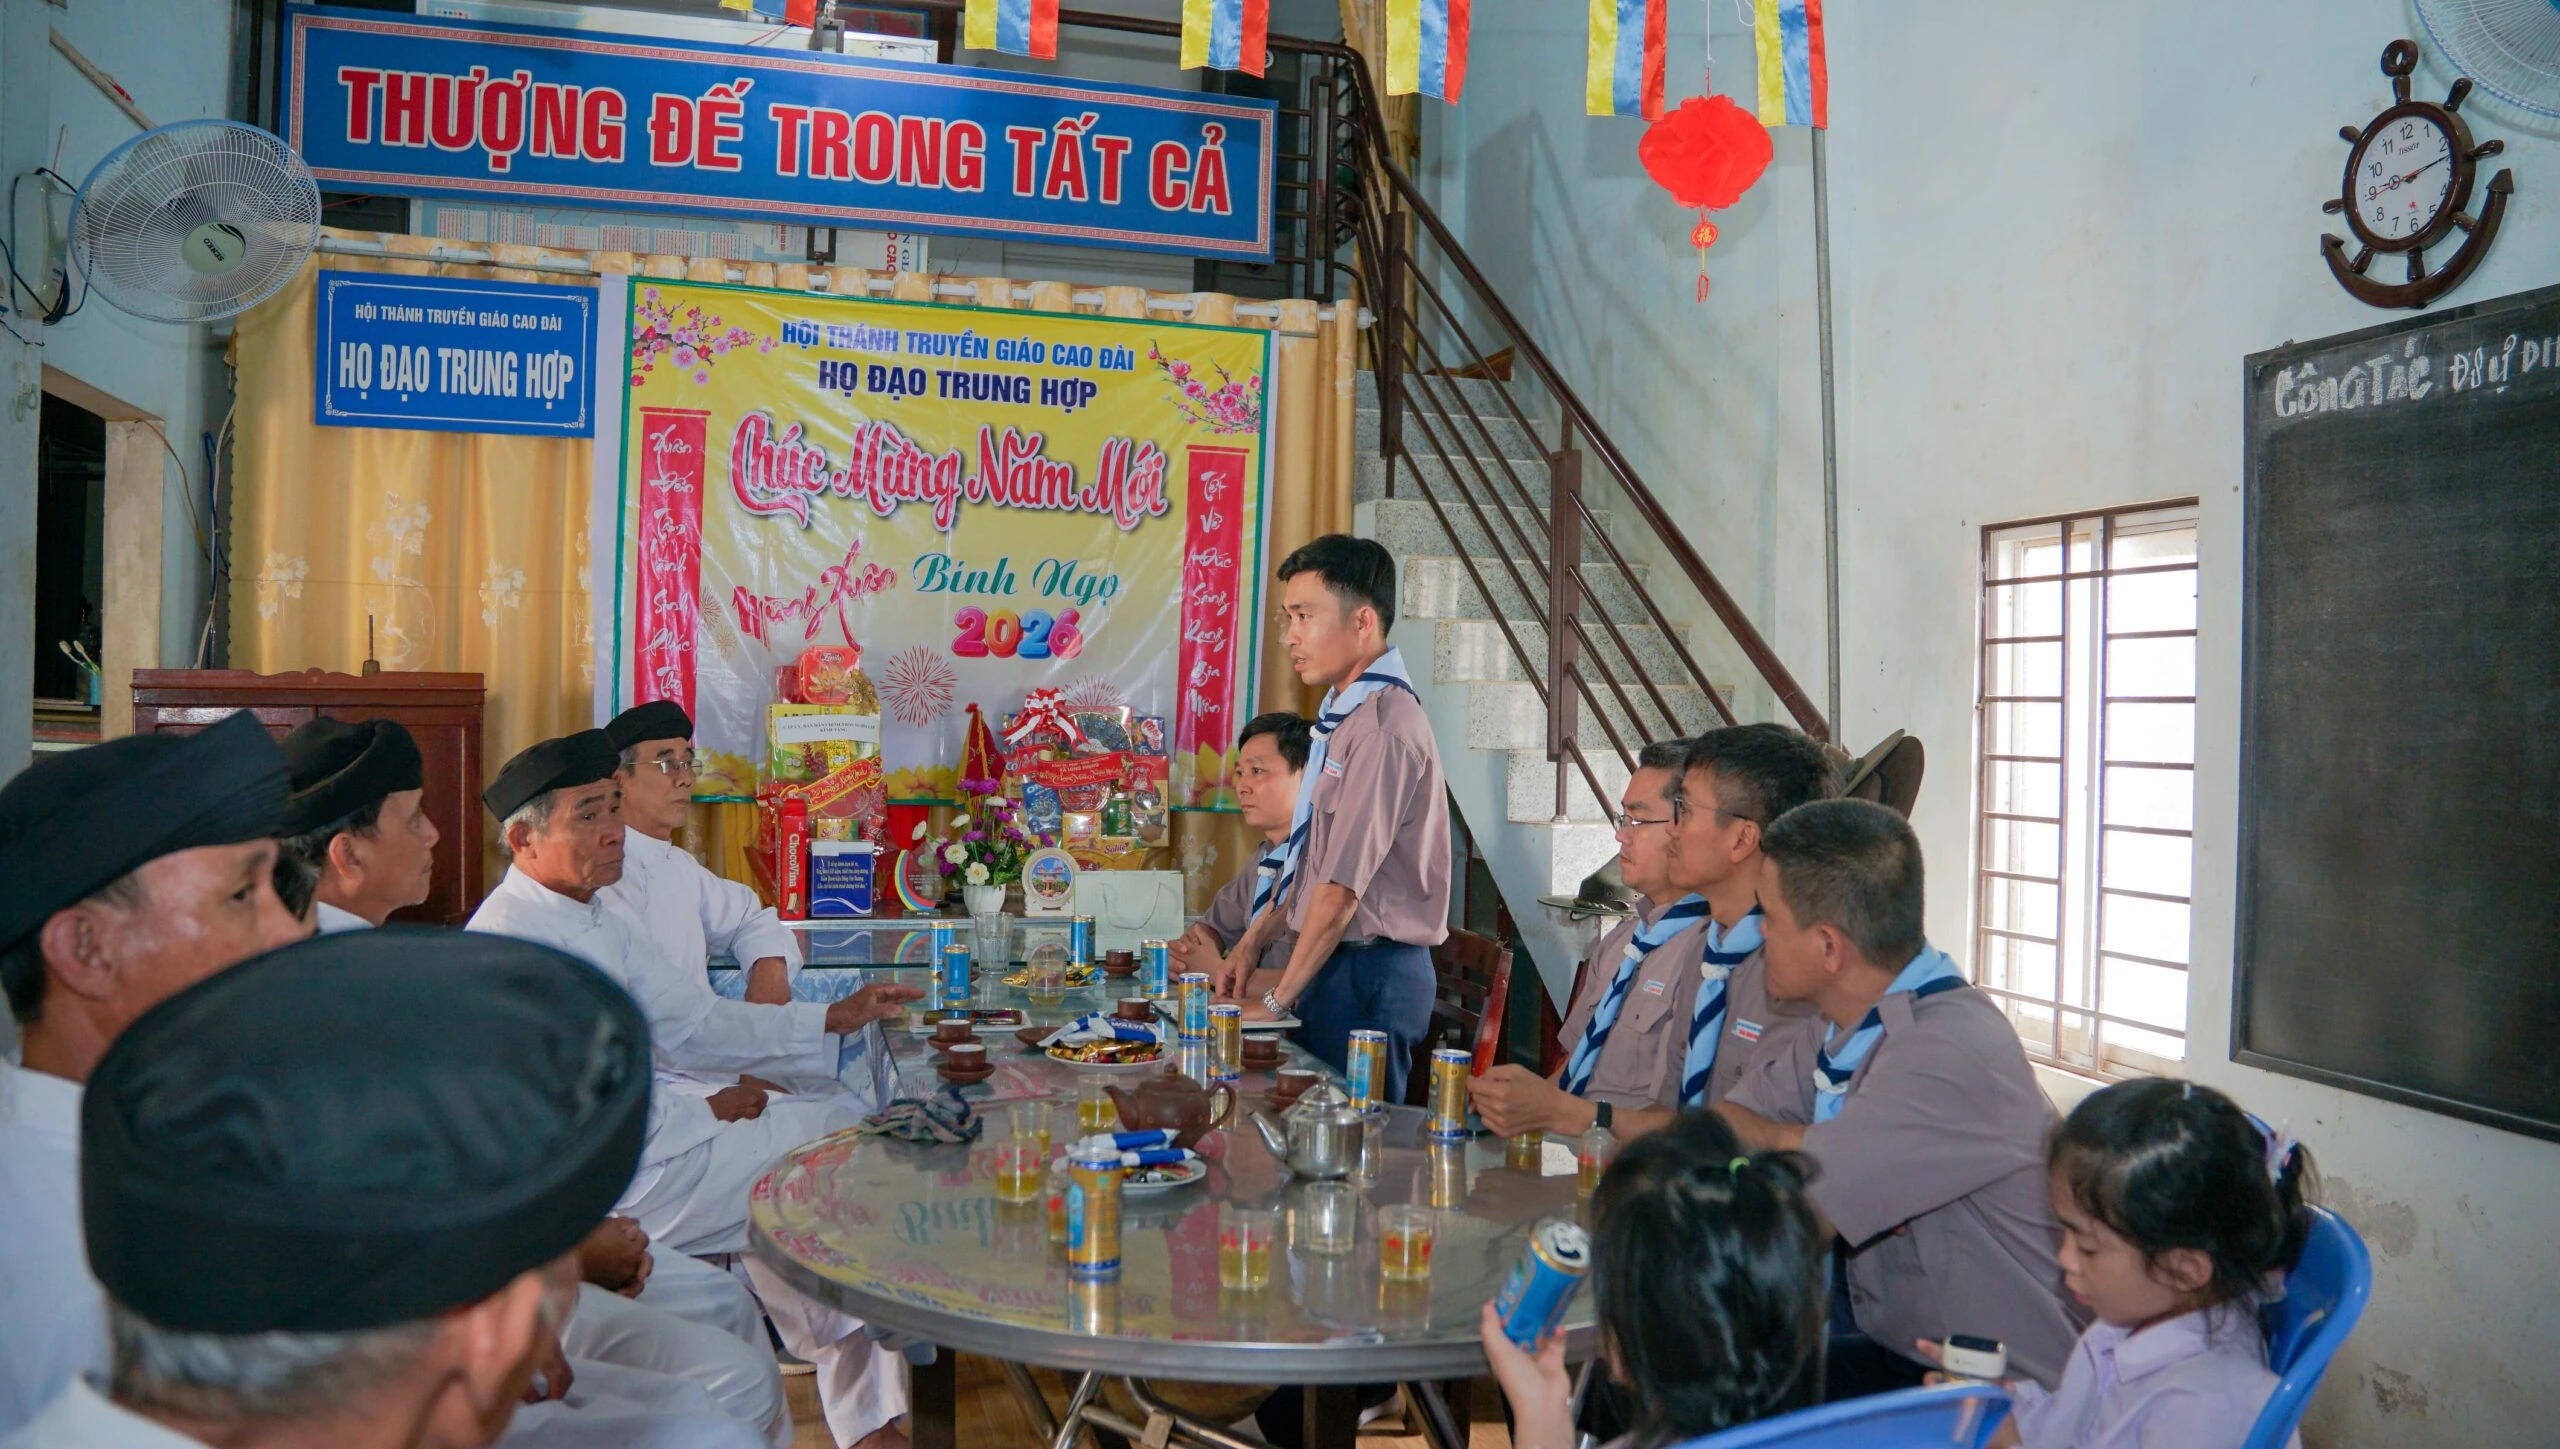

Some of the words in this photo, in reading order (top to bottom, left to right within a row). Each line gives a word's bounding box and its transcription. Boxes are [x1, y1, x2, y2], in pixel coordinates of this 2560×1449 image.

[338, 65, 626, 172] THƯỢNG
[647, 78, 754, 171] ĐẾ
[768, 103, 986, 193] TRONG
[1006, 112, 1132, 205] TẤT
[1150, 122, 1232, 215] CẢ
[2400, 123, 2414, 141] 12
[2424, 123, 2430, 138] 1
[2382, 139, 2394, 155] 11
[2370, 161, 2383, 178] 10
[2368, 186, 2377, 200] 9
[2376, 207, 2385, 221] 8
[2392, 216, 2400, 232] 7
[2410, 217, 2419, 232] 6
[1697, 227, 1712, 244] 福
[355, 302, 376, 323] HỘI
[381, 304, 423, 323] THÁNH
[427, 306, 476, 326] TRUYỀN
[479, 310, 508, 328] GIÁO
[512, 315, 537, 330] CAO
[540, 315, 562, 331] ĐÀI
[782, 320, 818, 348] HỘI
[826, 325, 899, 354] THÁNH
[906, 329, 989, 361] TRUYỀN
[995, 336, 1046, 364] GIÁO
[1052, 344, 1094, 368] CAO
[1099, 344, 1135, 372] ĐÀI
[339, 342, 373, 400] HỌ
[380, 344, 430, 402] ĐẠO
[437, 347, 518, 397] TRUNG
[525, 349, 575, 409] HỢP
[818, 360, 858, 397] HỌ
[867, 365, 927, 401] ĐẠO
[936, 370, 1032, 405] TRUNG
[1041, 377, 1098, 415] HỢP
[731, 410, 827, 530] Chúc
[831, 418, 962, 532] Mừng
[966, 423, 1077, 511] Năm
[1078, 436, 1170, 532] Mới
[912, 552, 1018, 597] Bính
[1032, 558, 1122, 607] Ngọ
[951, 605, 1084, 660] 2026
[789, 833, 800, 888] ChocoVina
